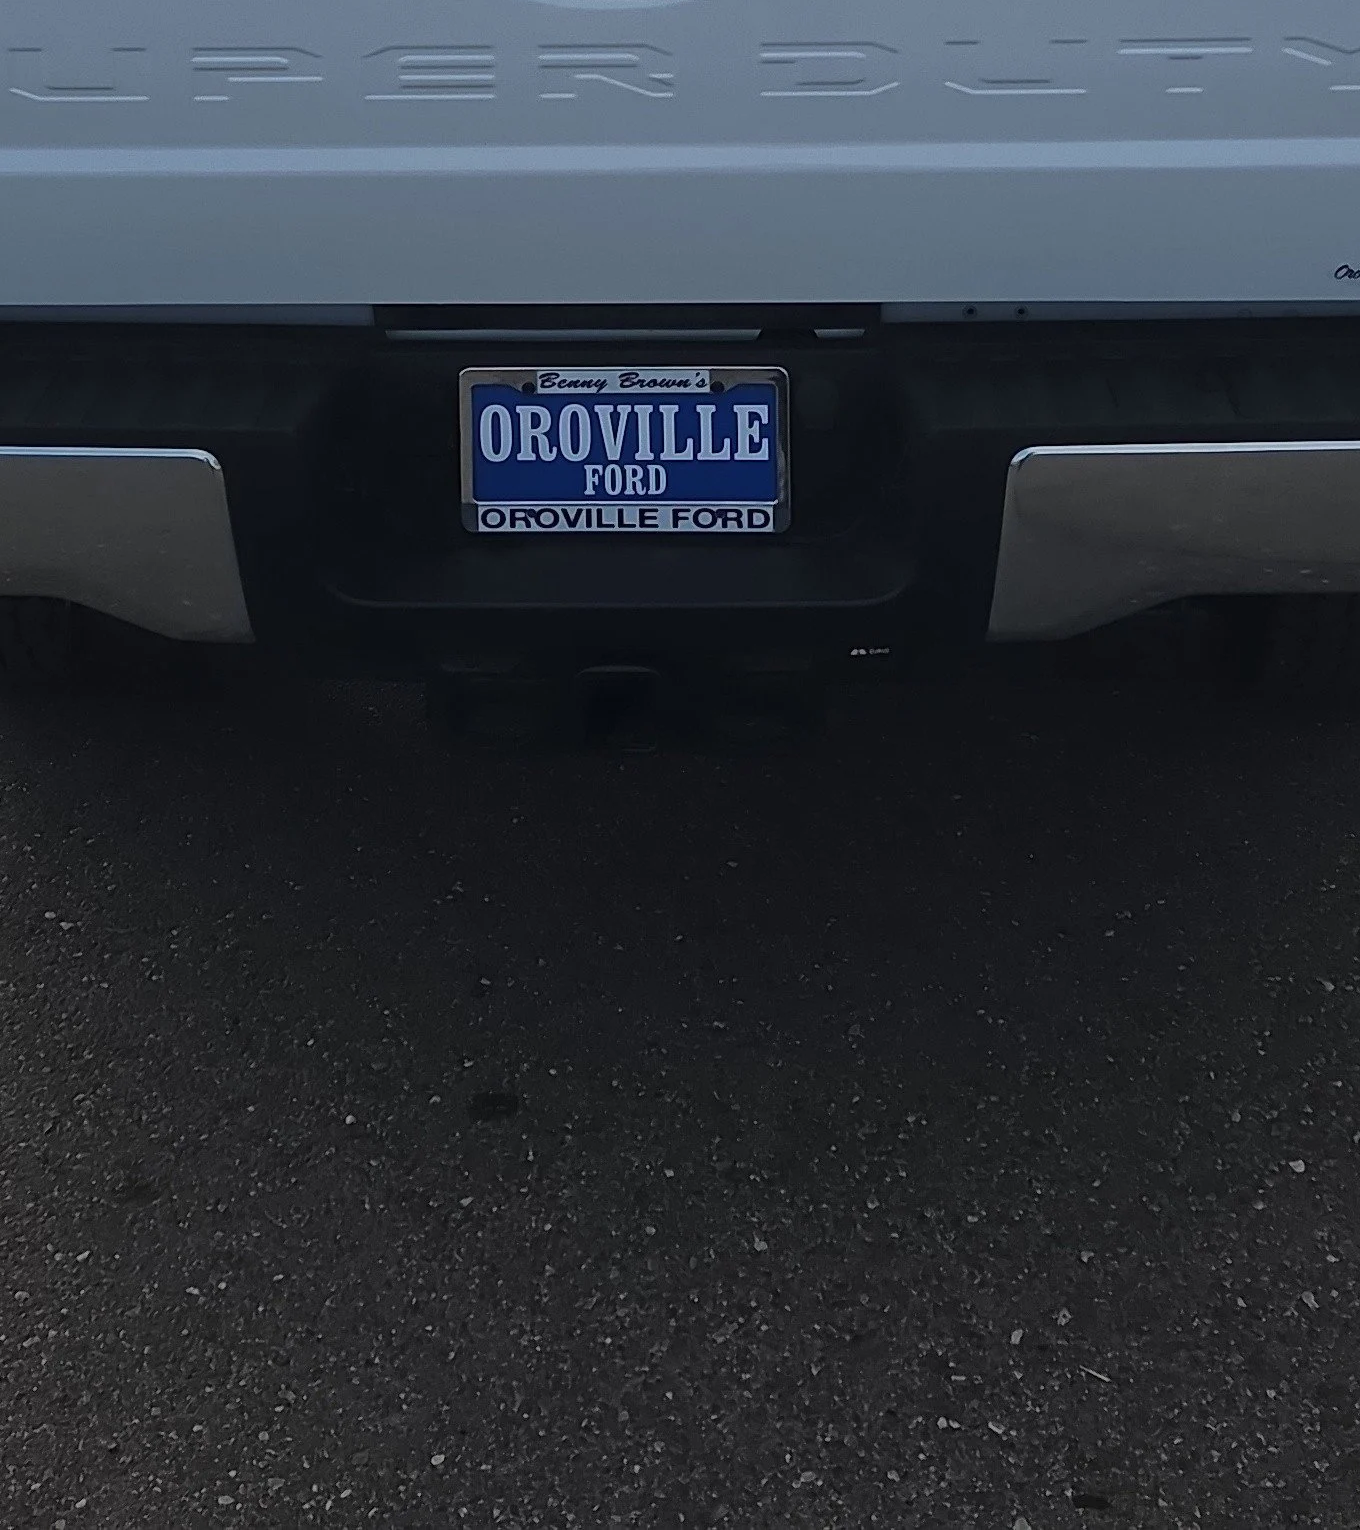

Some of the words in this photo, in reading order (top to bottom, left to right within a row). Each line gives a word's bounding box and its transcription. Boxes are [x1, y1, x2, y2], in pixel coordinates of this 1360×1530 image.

[538, 372, 608, 393] Benny
[618, 372, 708, 390] Brown's
[479, 403, 770, 462] OROVILLE
[583, 464, 668, 496] FORD
[480, 507, 660, 530] OROVILLE
[671, 507, 772, 530] FORD
